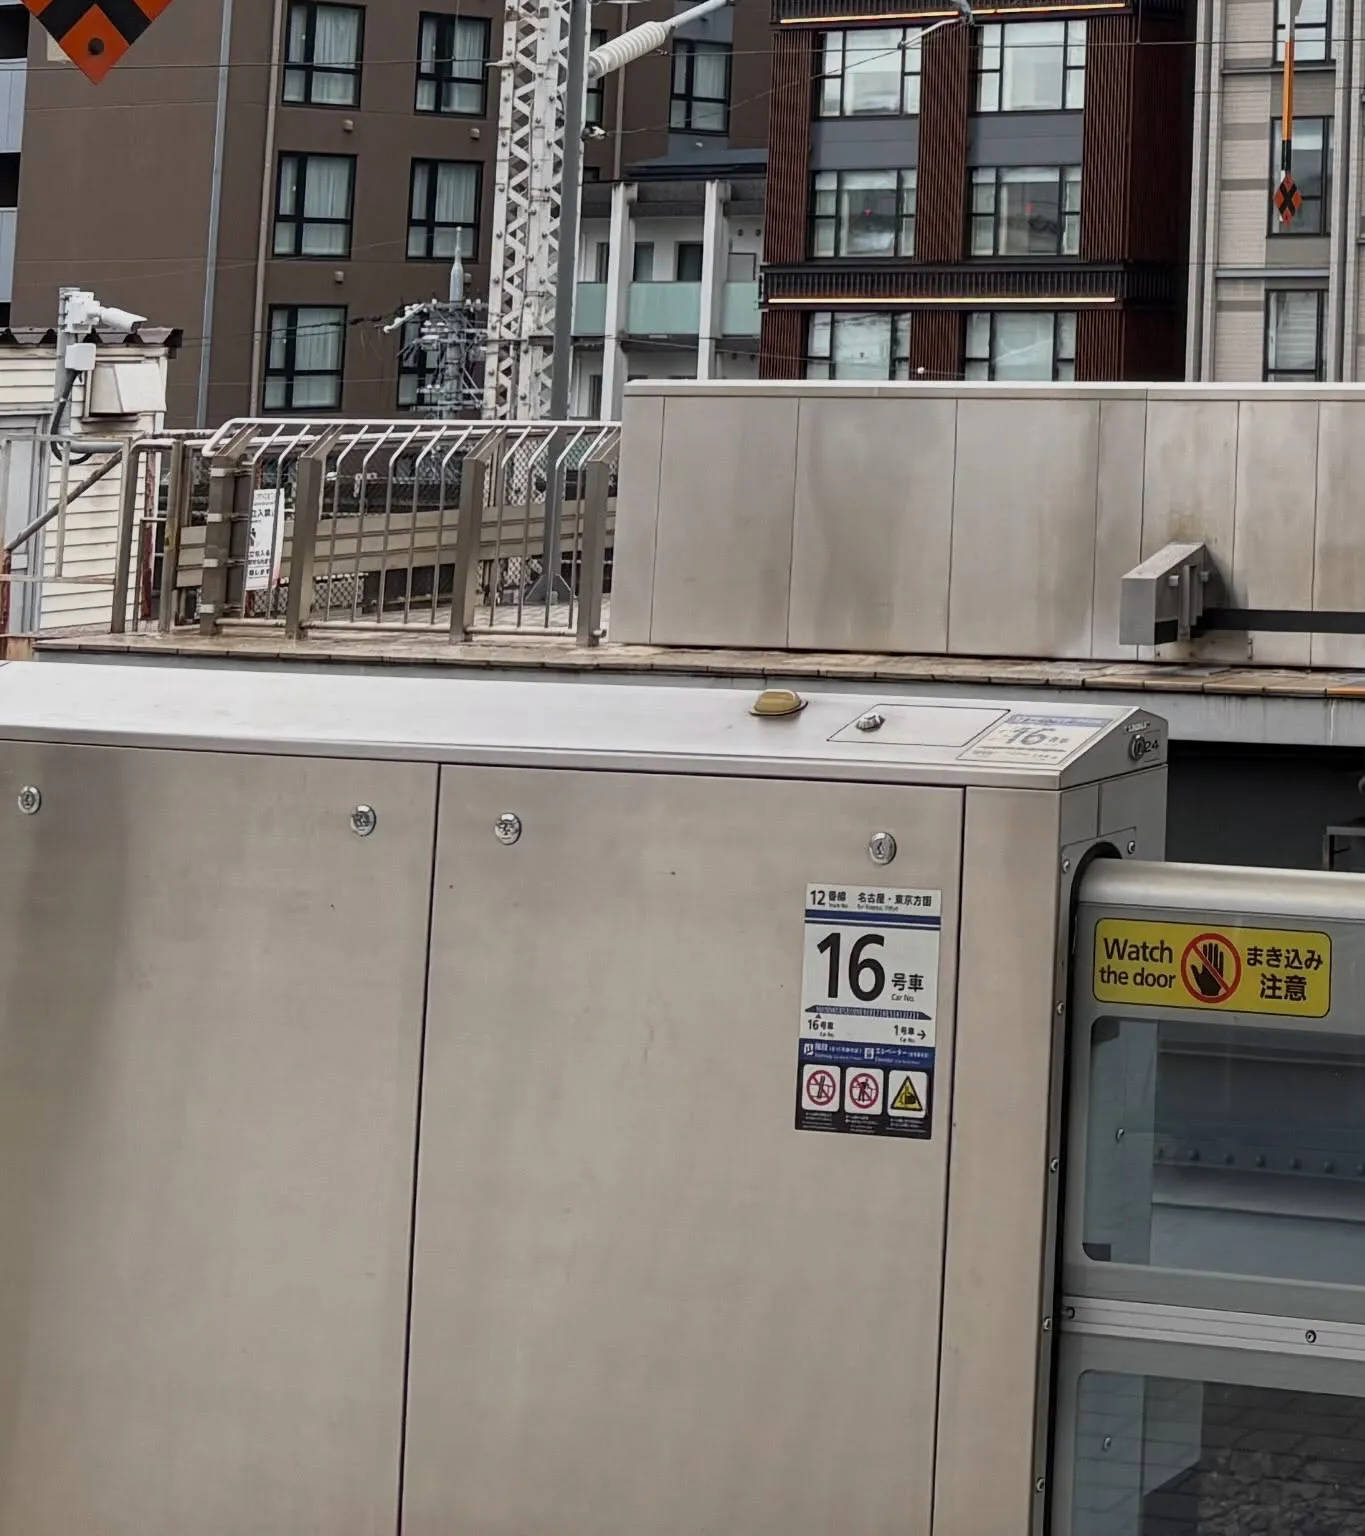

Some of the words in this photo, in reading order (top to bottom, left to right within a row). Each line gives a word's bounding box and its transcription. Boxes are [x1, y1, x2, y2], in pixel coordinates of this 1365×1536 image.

[1103, 937, 1173, 964] Watch
[1246, 946, 1324, 971] まき込み
[1099, 965, 1129, 986] the
[1133, 967, 1176, 989] door
[1259, 973, 1308, 1002] 注意
